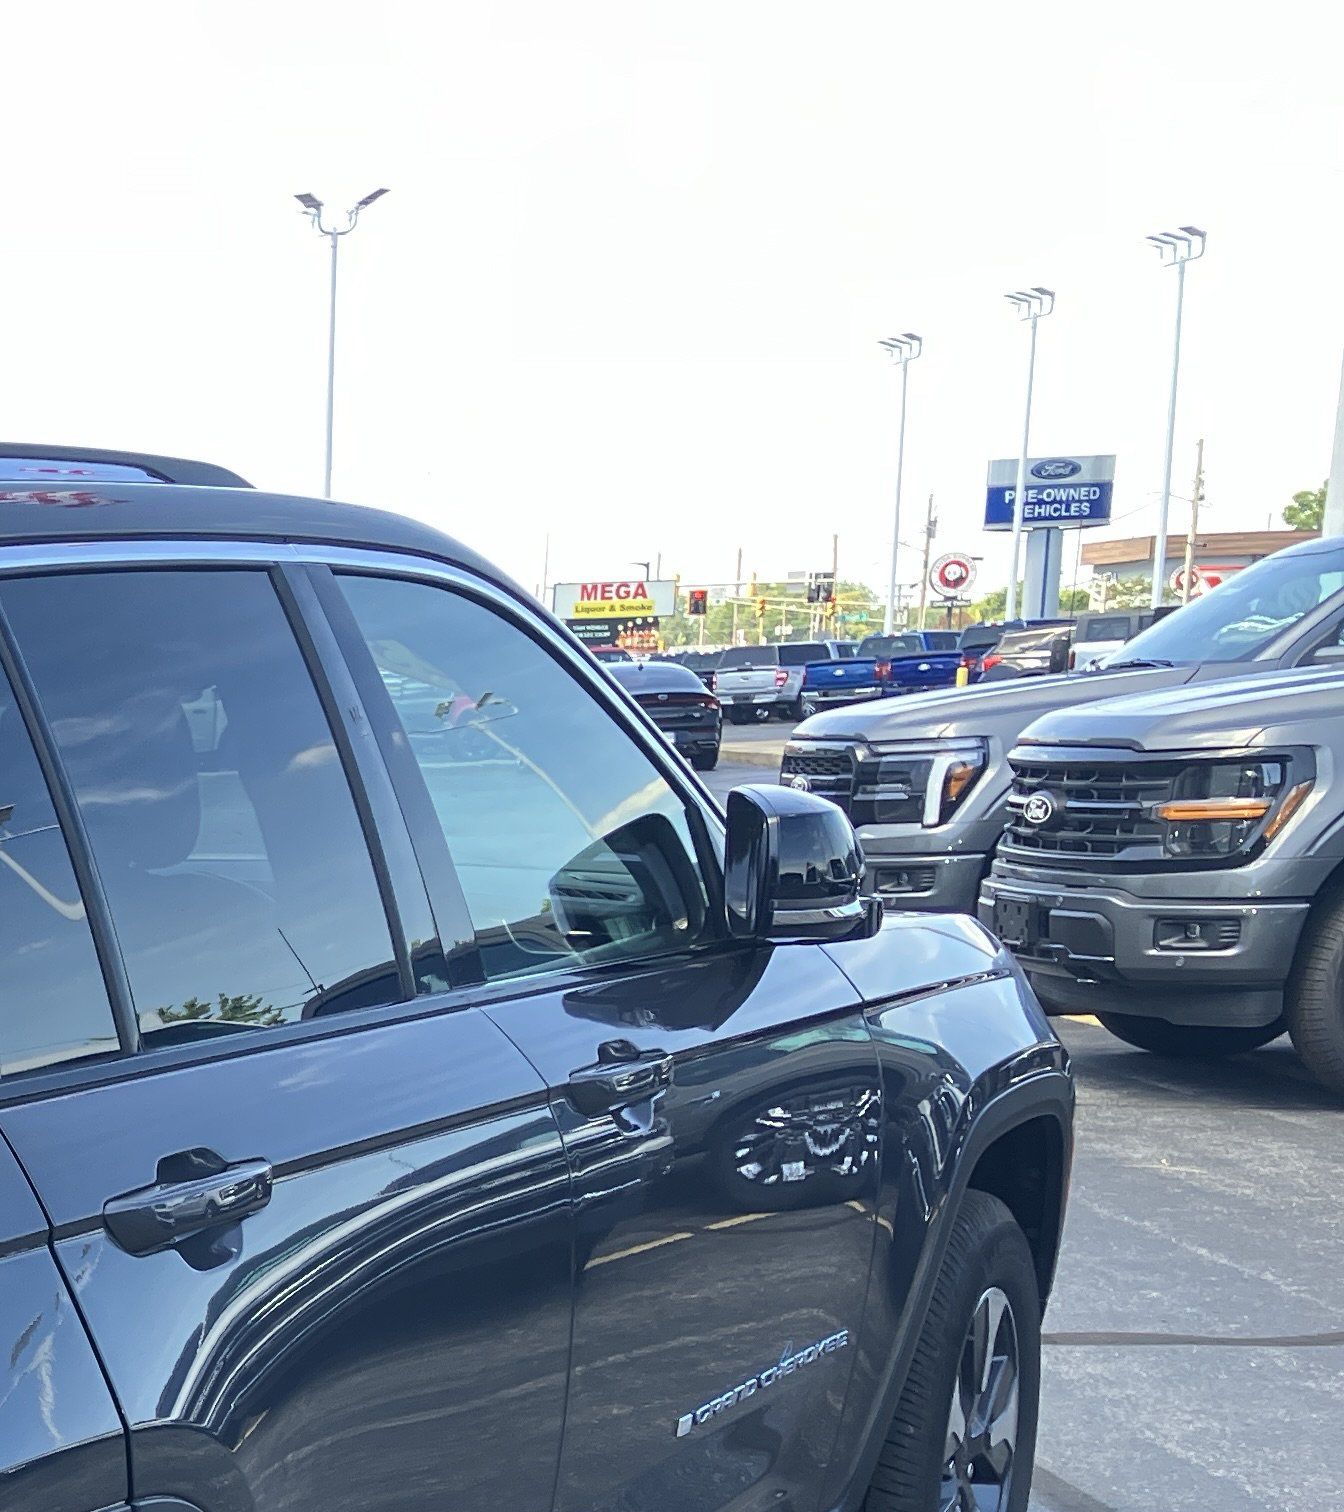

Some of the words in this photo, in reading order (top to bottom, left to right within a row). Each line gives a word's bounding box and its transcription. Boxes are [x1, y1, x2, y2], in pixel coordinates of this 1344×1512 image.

[1004, 487, 1101, 504] PE-OWNED
[1015, 502, 1091, 518] EHICLES
[580, 581, 648, 602] MEGA
[574, 603, 606, 614] Liquor
[609, 603, 616, 612] &
[620, 603, 653, 612] Smoke
[695, 1377, 758, 1424] GRAND
[760, 1329, 849, 1388] CHEROKEE
